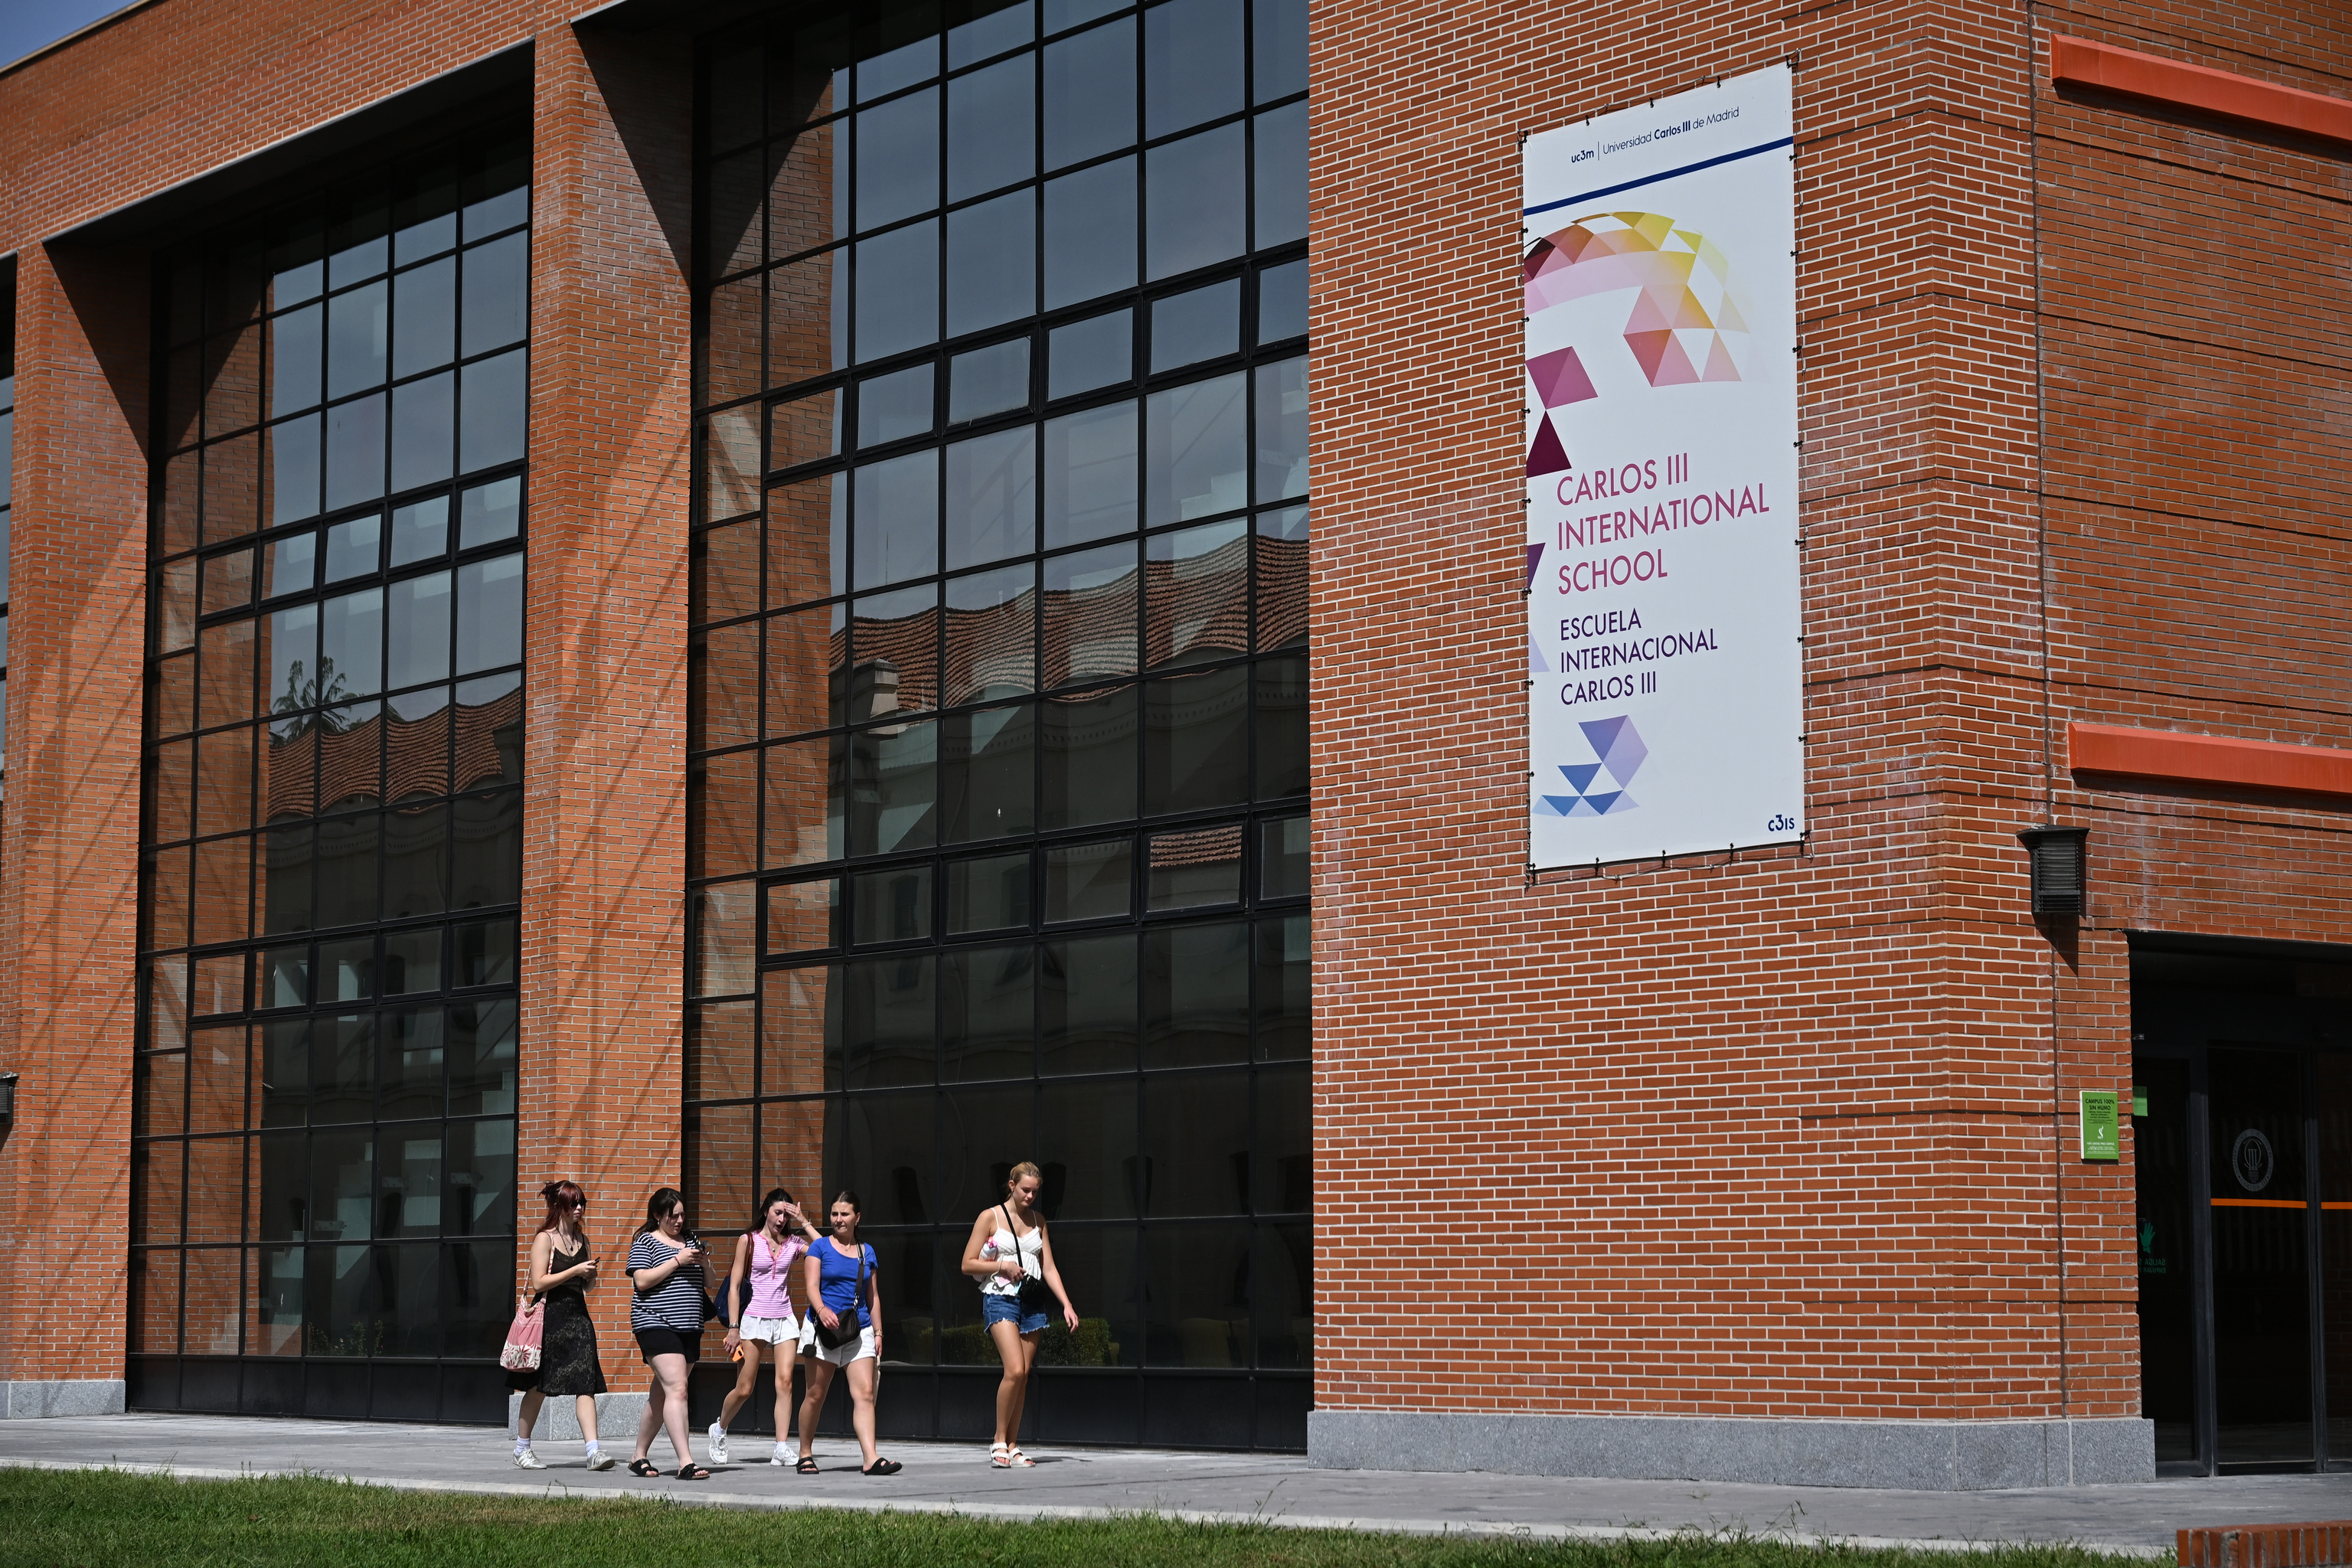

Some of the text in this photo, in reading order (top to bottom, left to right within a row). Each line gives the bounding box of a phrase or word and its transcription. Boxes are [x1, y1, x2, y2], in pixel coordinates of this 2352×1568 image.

[1571, 106, 1740, 164] uc3m Universidad Carlos III de Madrid
[1557, 452, 1689, 506] CARLOS III
[1558, 482, 1770, 551] INTERNATIONAL
[1558, 548, 1668, 595] SCHOOL
[1560, 607, 1642, 642] ESCUELA
[1561, 628, 1718, 674] INTERNACIONAL
[1560, 671, 1657, 706] CARLOS III
